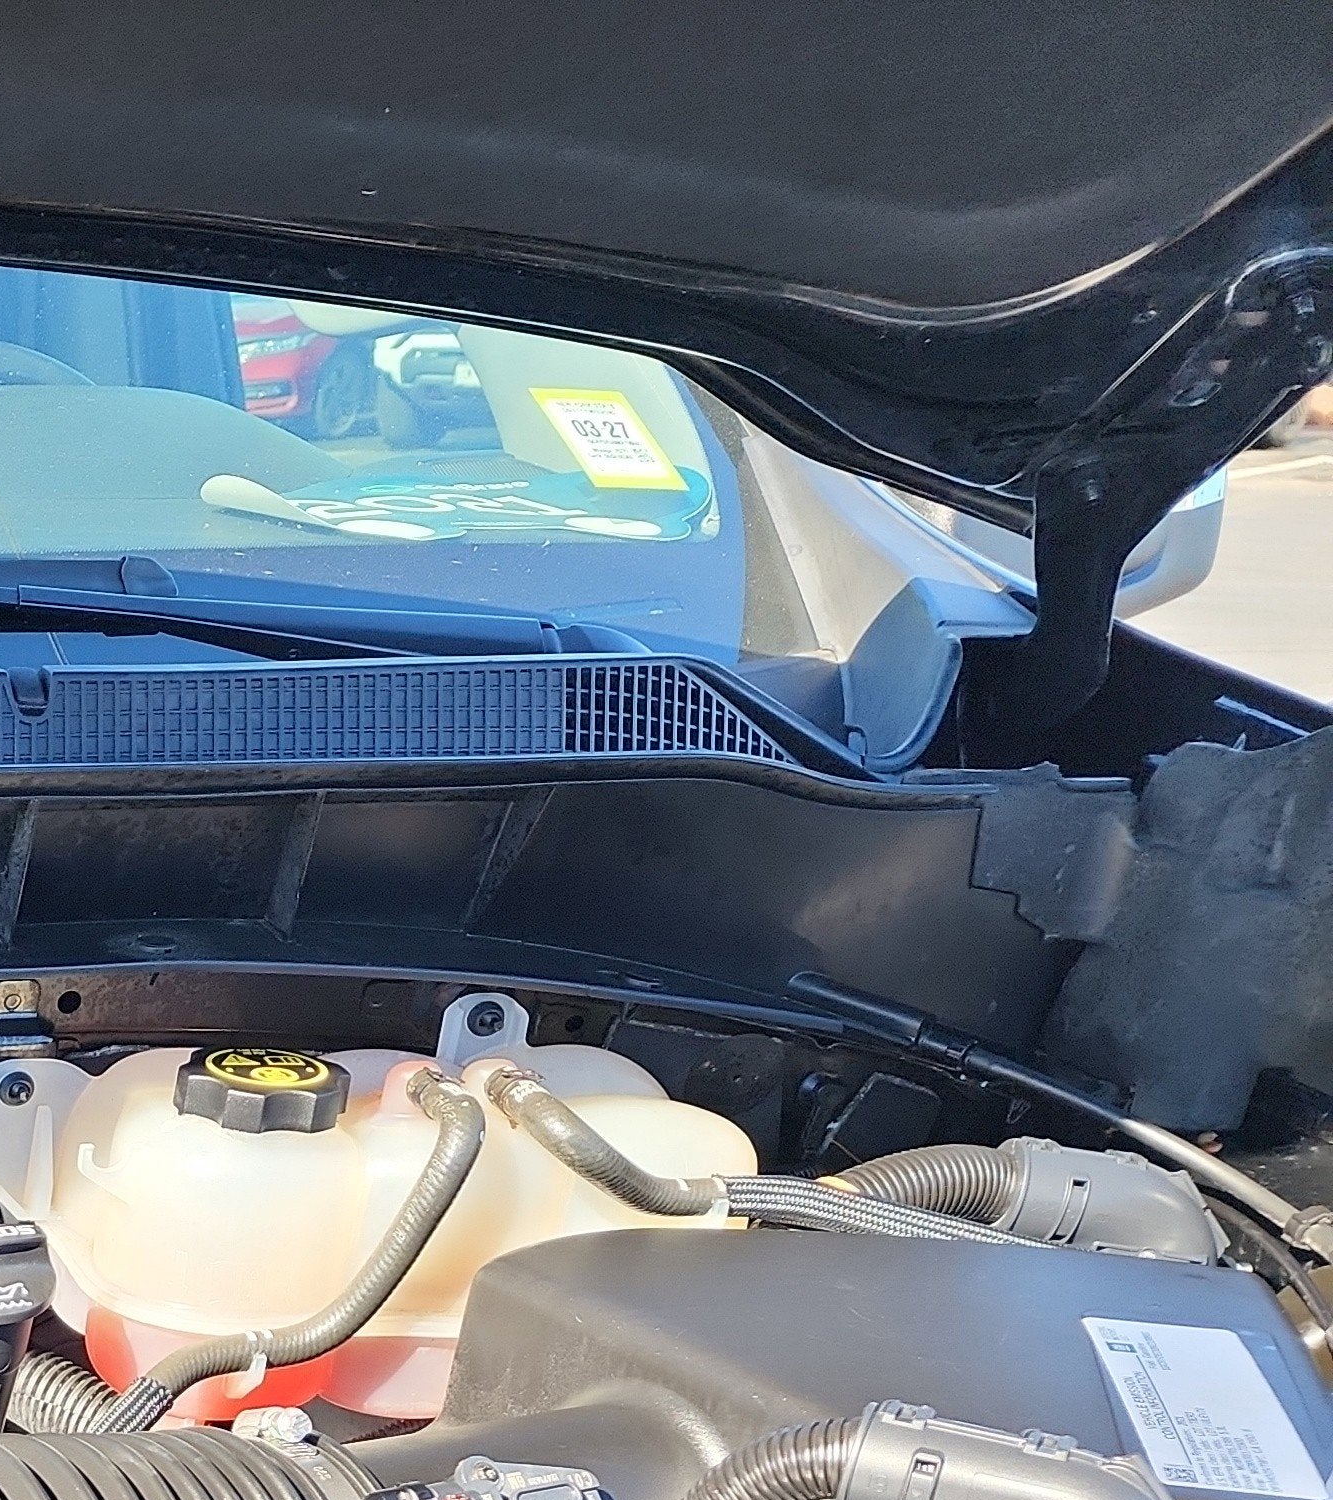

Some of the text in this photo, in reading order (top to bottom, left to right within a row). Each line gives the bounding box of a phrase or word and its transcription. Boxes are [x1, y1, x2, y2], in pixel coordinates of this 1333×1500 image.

[293, 492, 589, 520] 2021
[1120, 1375, 1159, 1430] VEHICLE EMISSION
[1130, 1369, 1161, 1409] INFORMATION
[1150, 1409, 1178, 1440] CONTROL
